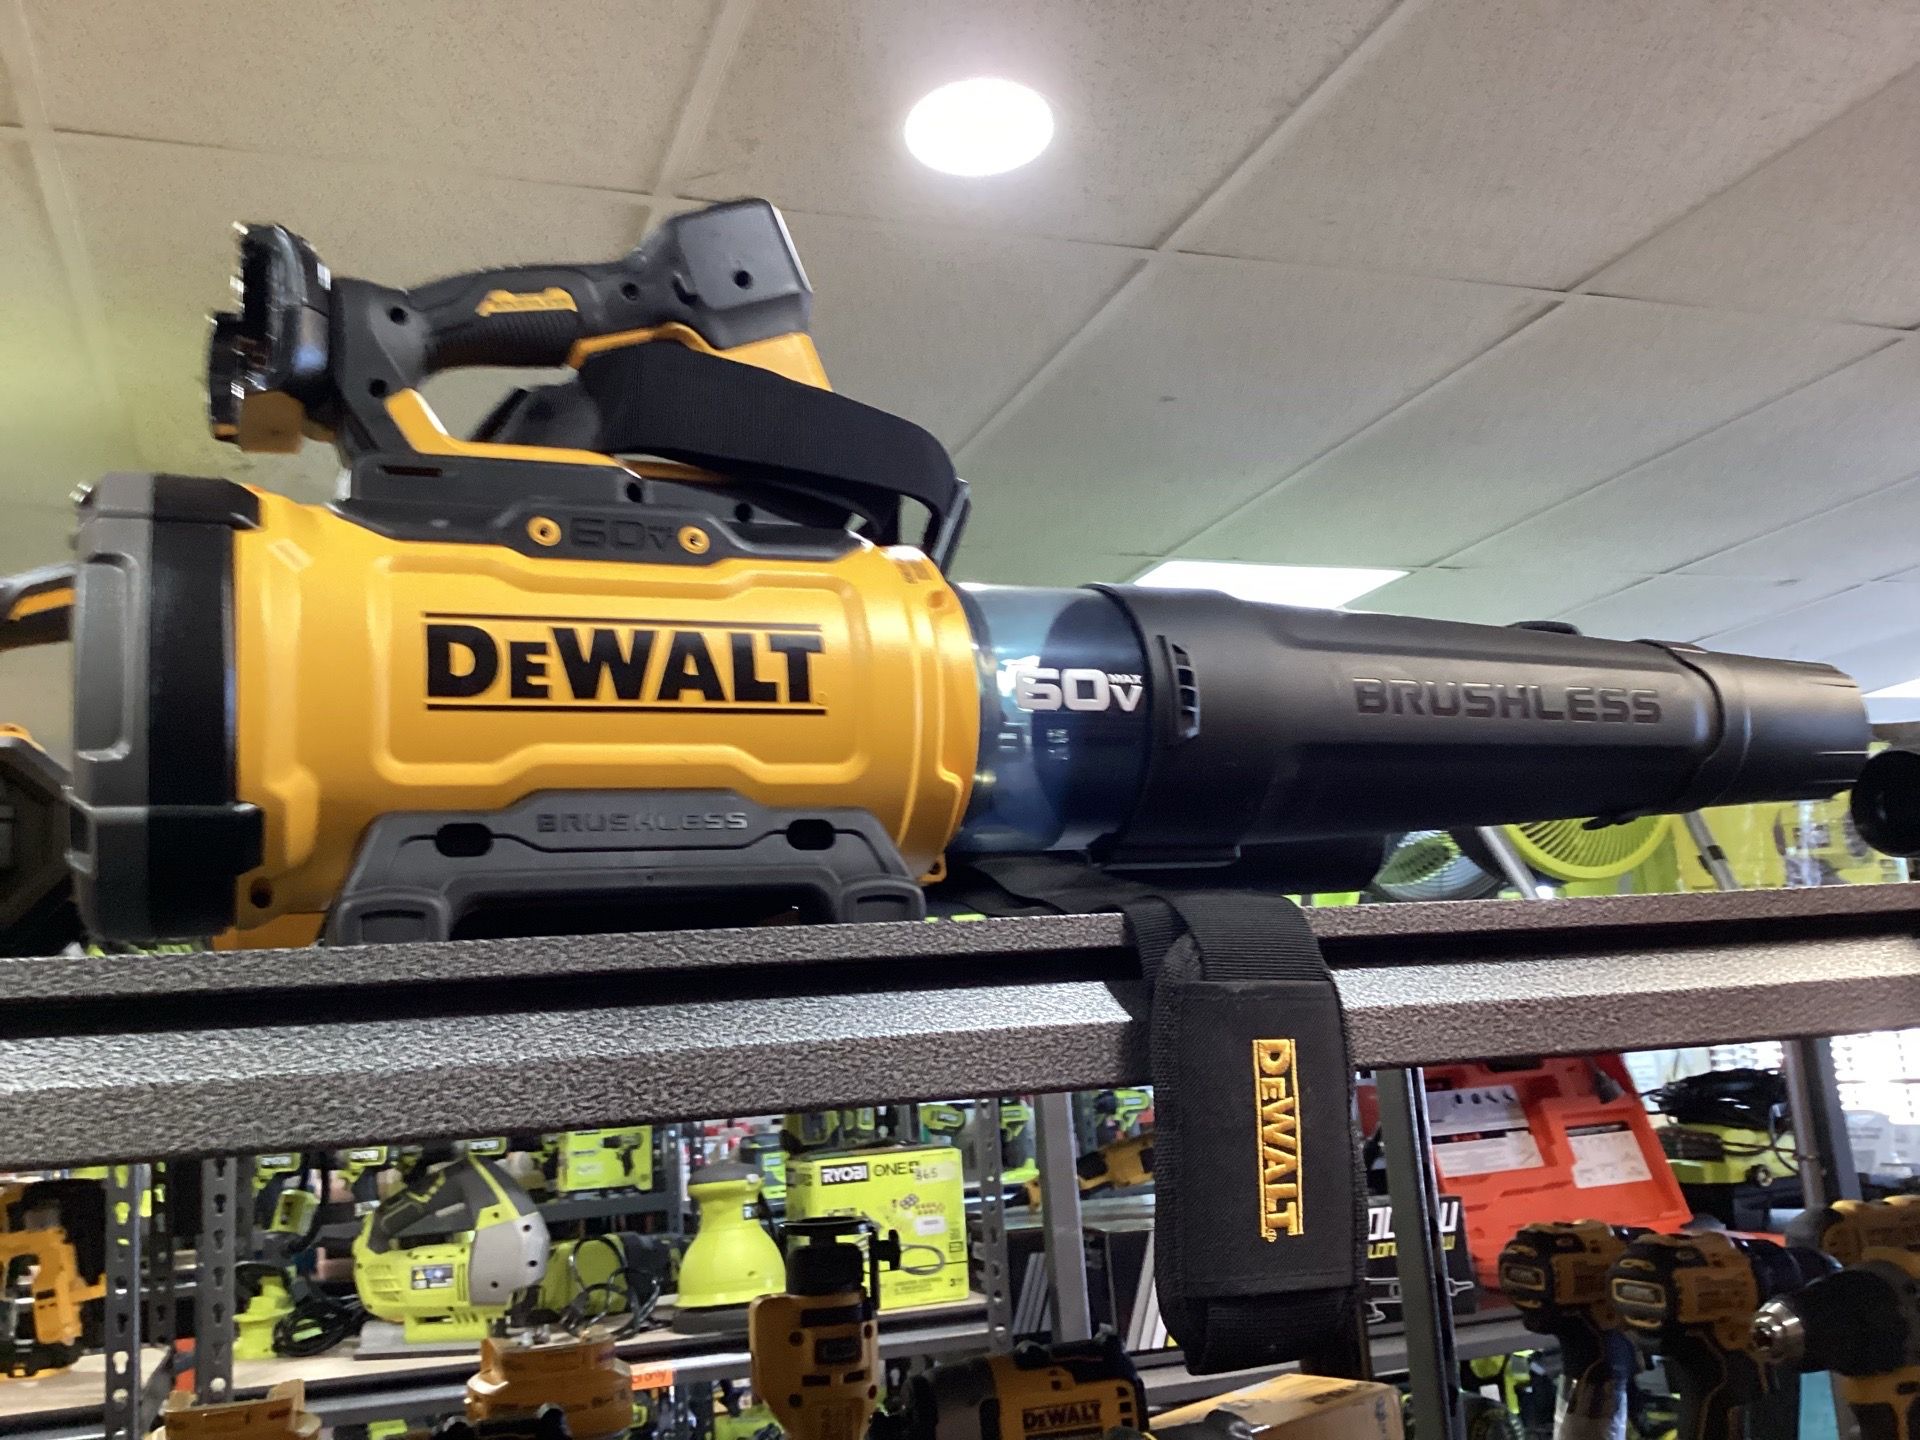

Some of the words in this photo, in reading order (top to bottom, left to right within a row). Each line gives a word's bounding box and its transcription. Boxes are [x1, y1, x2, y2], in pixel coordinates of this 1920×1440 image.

[1352, 677, 1662, 724] BRUSHLESS
[536, 812, 748, 832] BRUSHLESS
[821, 1166, 868, 1184] RYOBI
